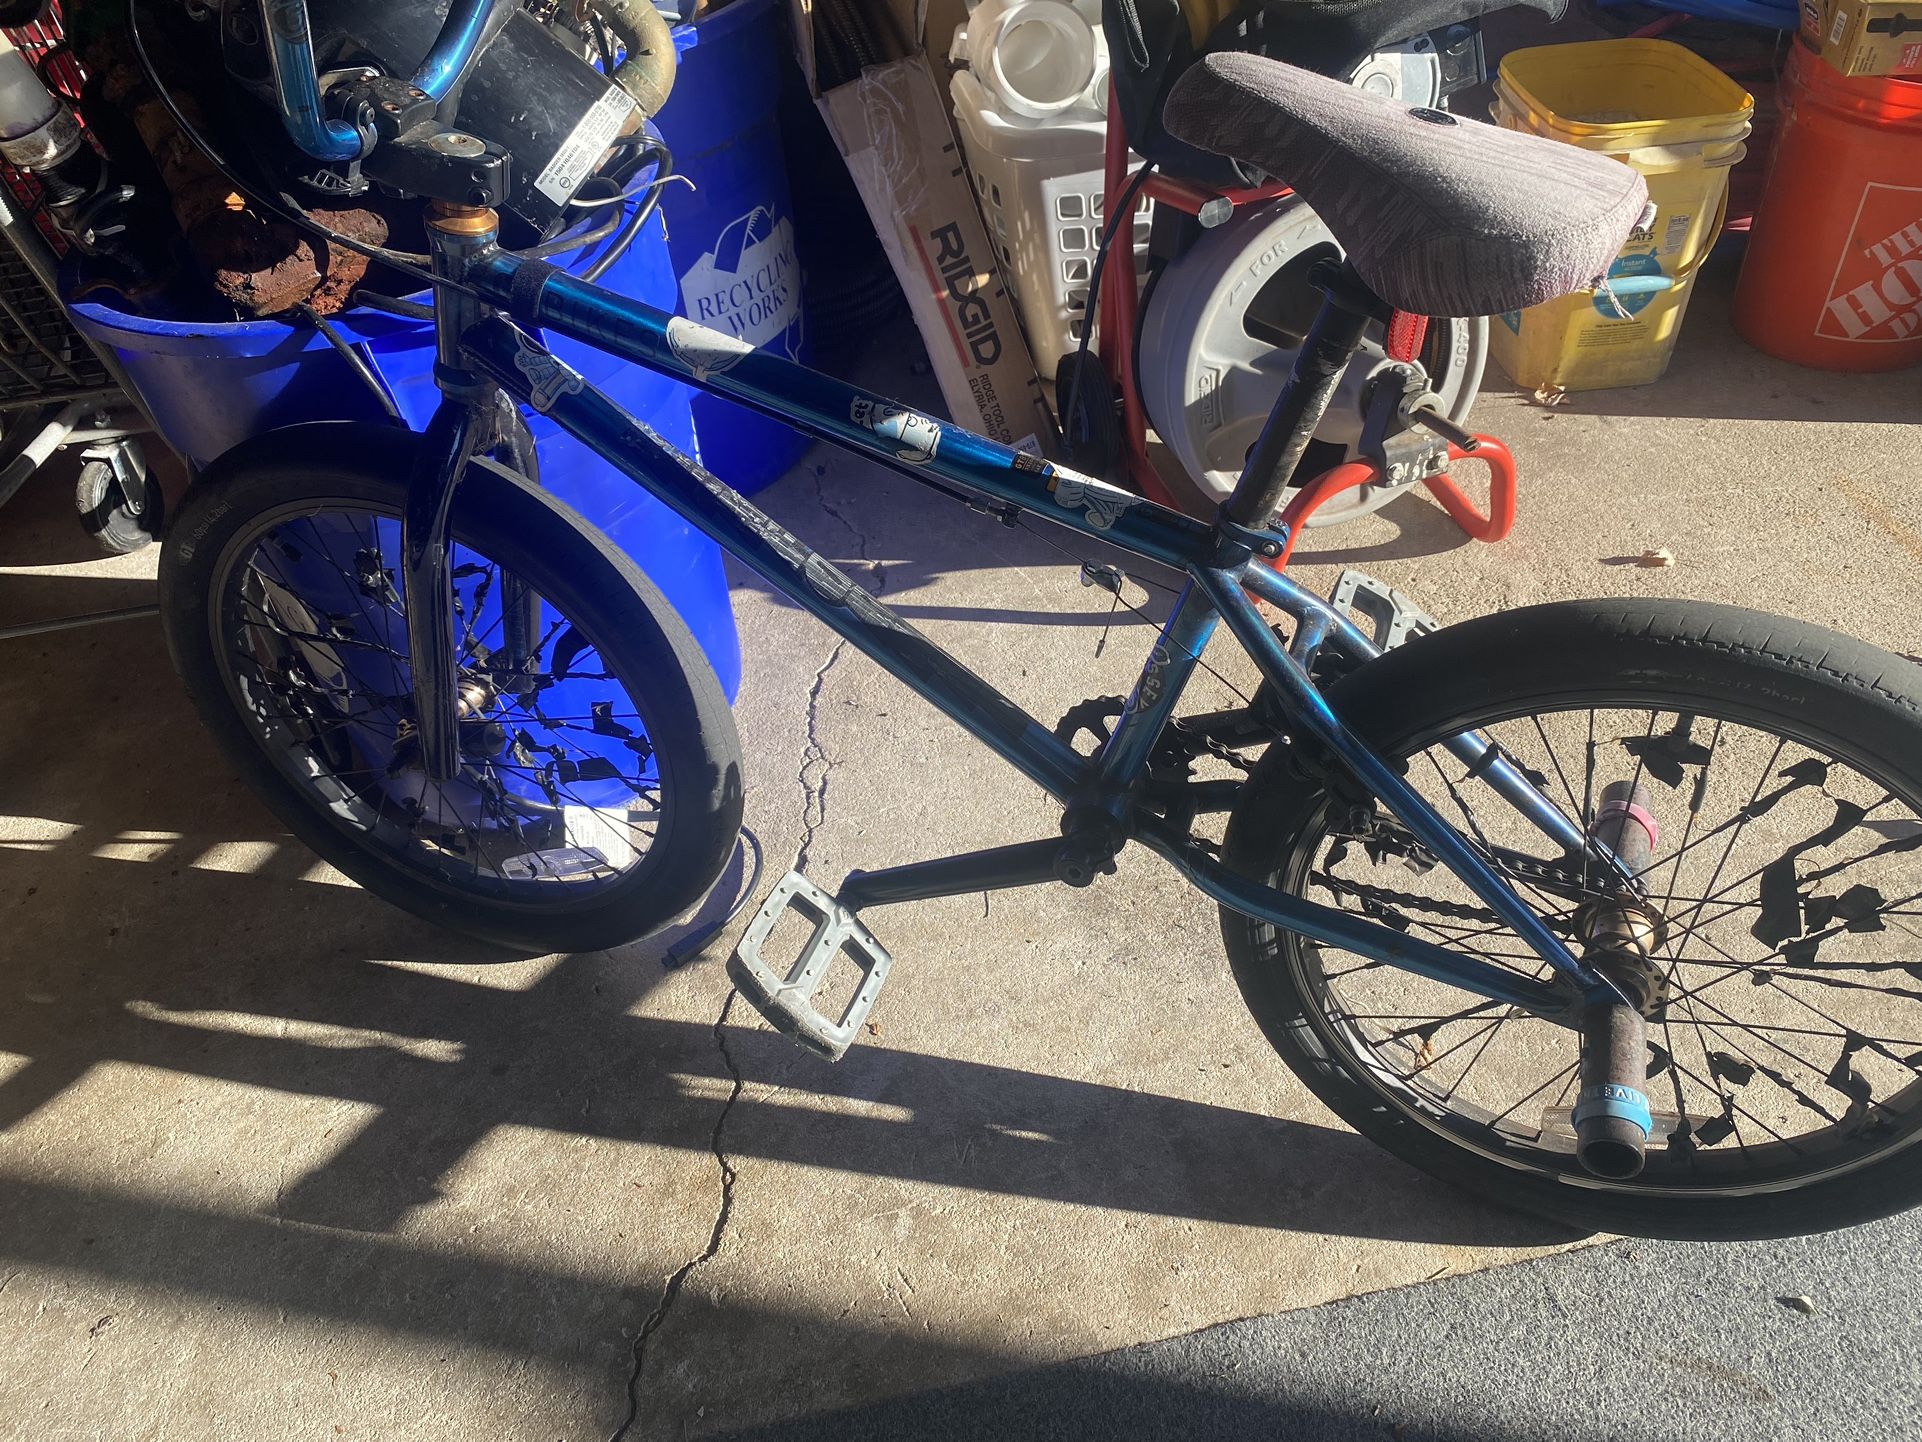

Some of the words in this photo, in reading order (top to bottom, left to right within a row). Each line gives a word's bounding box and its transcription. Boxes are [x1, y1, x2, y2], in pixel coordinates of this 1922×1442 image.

[1249, 239, 1289, 278] FOR
[1863, 217, 1922, 268] TH
[728, 285, 789, 335] WORKS
[930, 221, 1002, 368] RIDGID
[980, 373, 997, 404] RIDGE
[990, 403, 1006, 428] TOOL
[1000, 426, 1014, 446] CO
